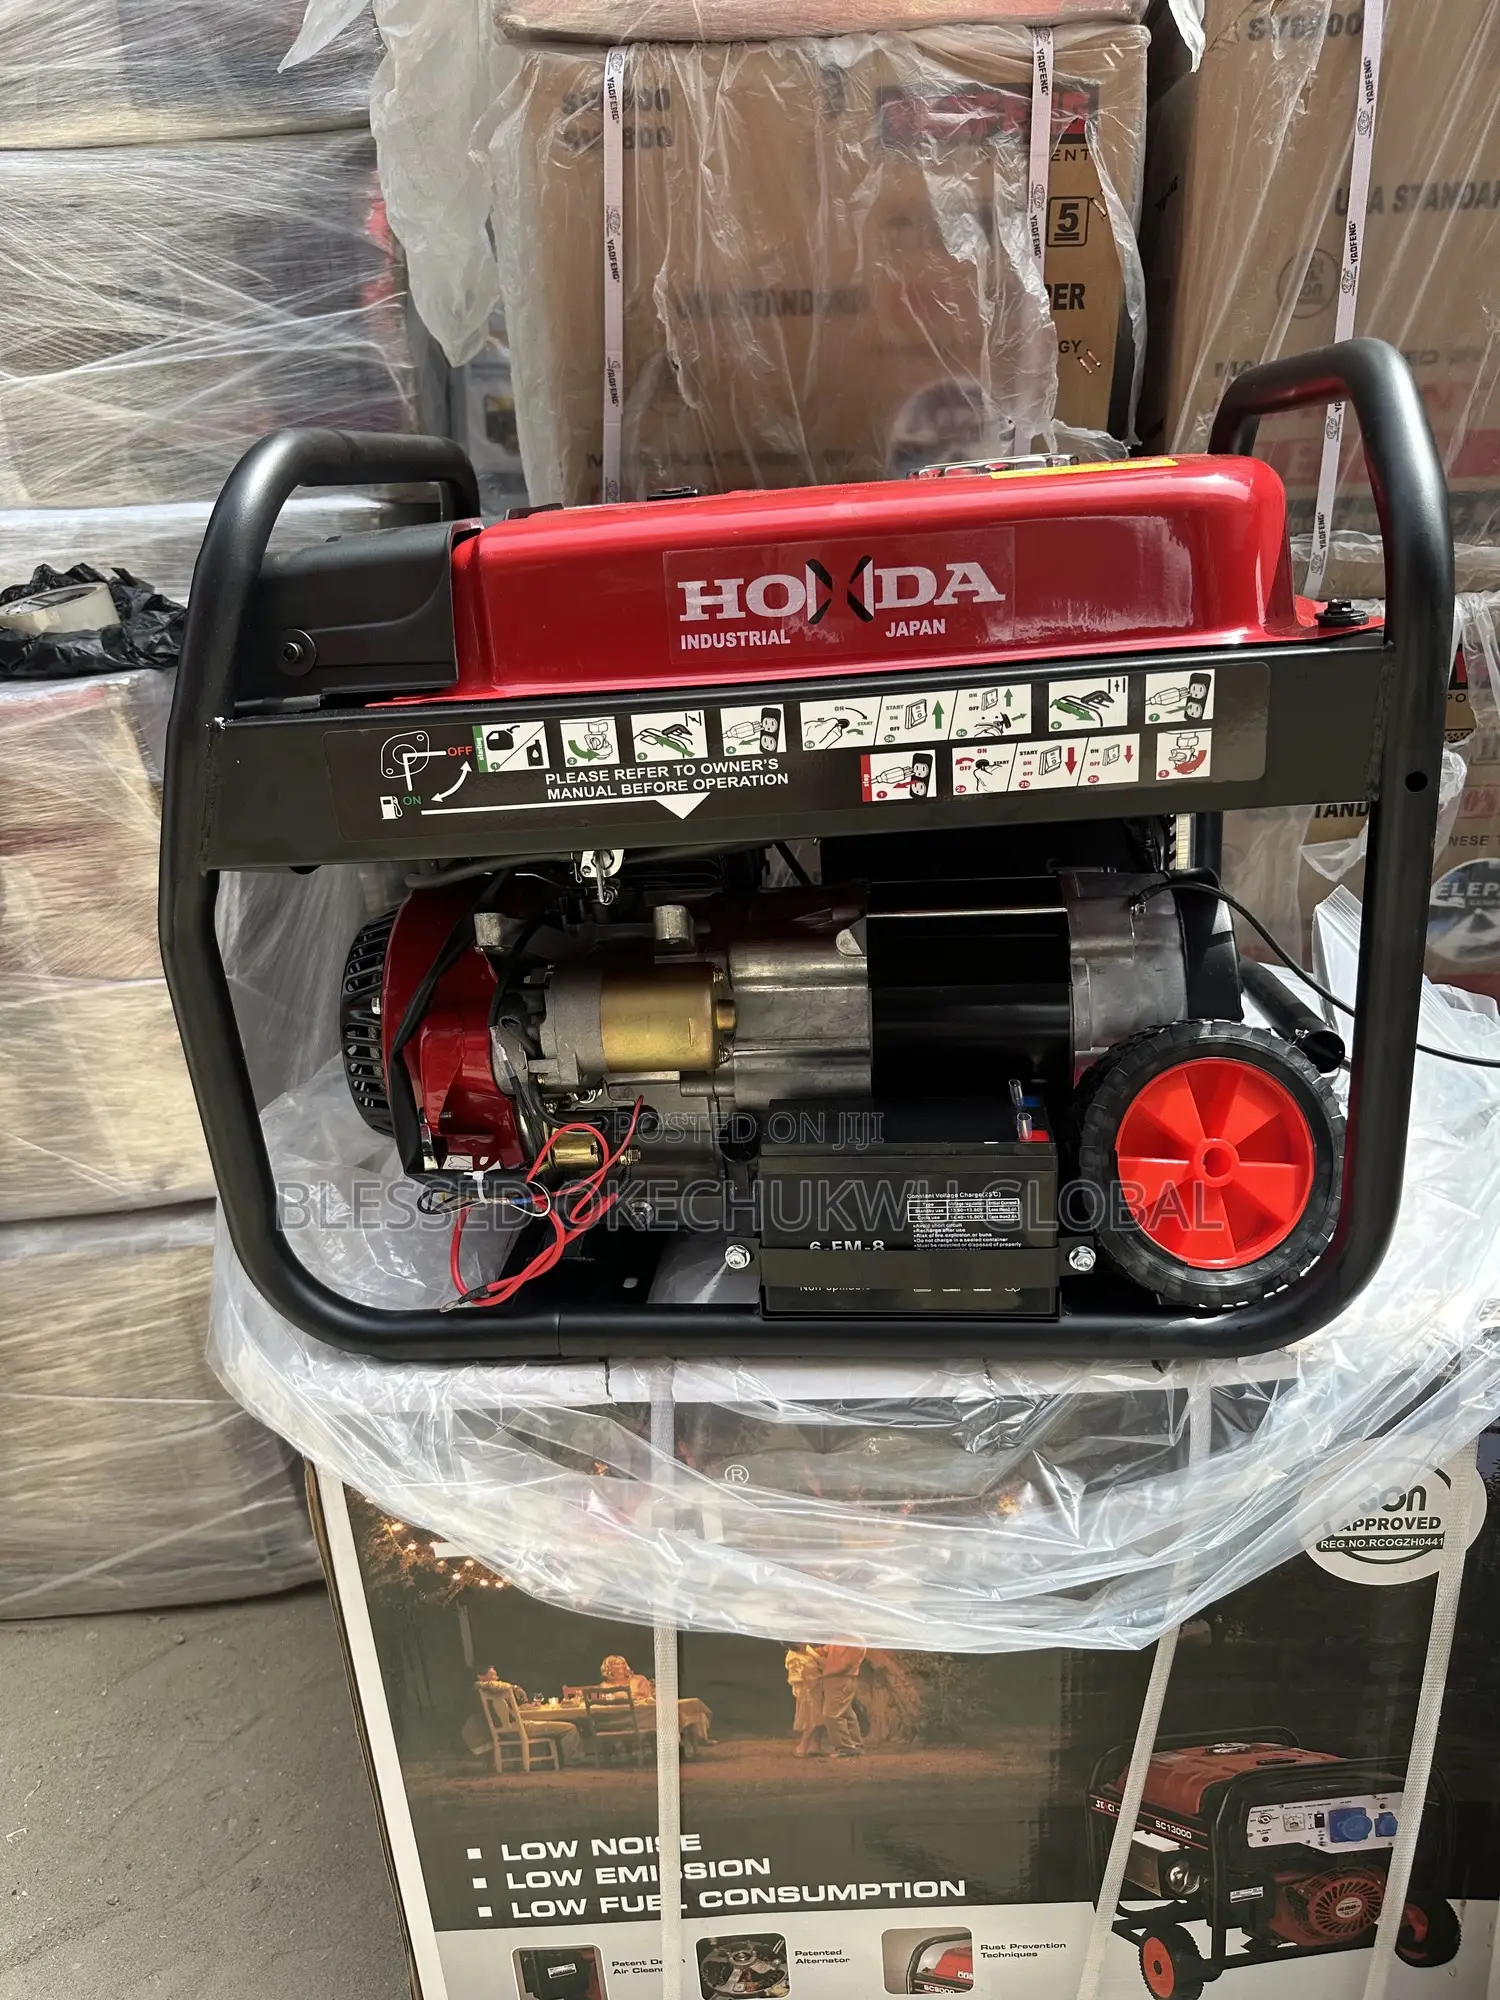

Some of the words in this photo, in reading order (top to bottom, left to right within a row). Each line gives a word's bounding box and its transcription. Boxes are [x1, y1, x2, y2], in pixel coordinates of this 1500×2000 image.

[1335, 186, 1384, 217] UA
[1057, 203, 1080, 232] 5
[885, 619, 946, 638] JAPAN
[681, 629, 791, 650] INDUSTRIAL
[447, 746, 472, 757] OFF
[545, 770, 610, 785] PLEASE
[614, 766, 669, 781] REFER
[673, 764, 696, 777] TO
[700, 758, 779, 775] OWNER'S
[547, 785, 617, 800] MANUAL
[621, 779, 688, 795] BEFORE
[692, 773, 789, 790] OPERATION
[403, 796, 421, 805] ON
[1437, 882, 1500, 897] ELEP
[1155, 1820, 1192, 1839] SC13000
[501, 1840, 578, 1861] LOW
[591, 1834, 702, 1856] NOIE
[506, 1868, 583, 1889] LOW
[595, 1857, 771, 1885] EMISION
[511, 1898, 587, 1919] LOW
[698, 1880, 966, 1909] CONSUMPTION
[794, 1949, 842, 1957] Patented
[980, 1943, 1006, 1951] Rust
[1010, 1942, 1067, 1950] Prevention
[981, 1951, 1038, 1959] Techniques
[611, 1959, 647, 1967] Patent
[795, 1956, 850, 1965] Alternator
